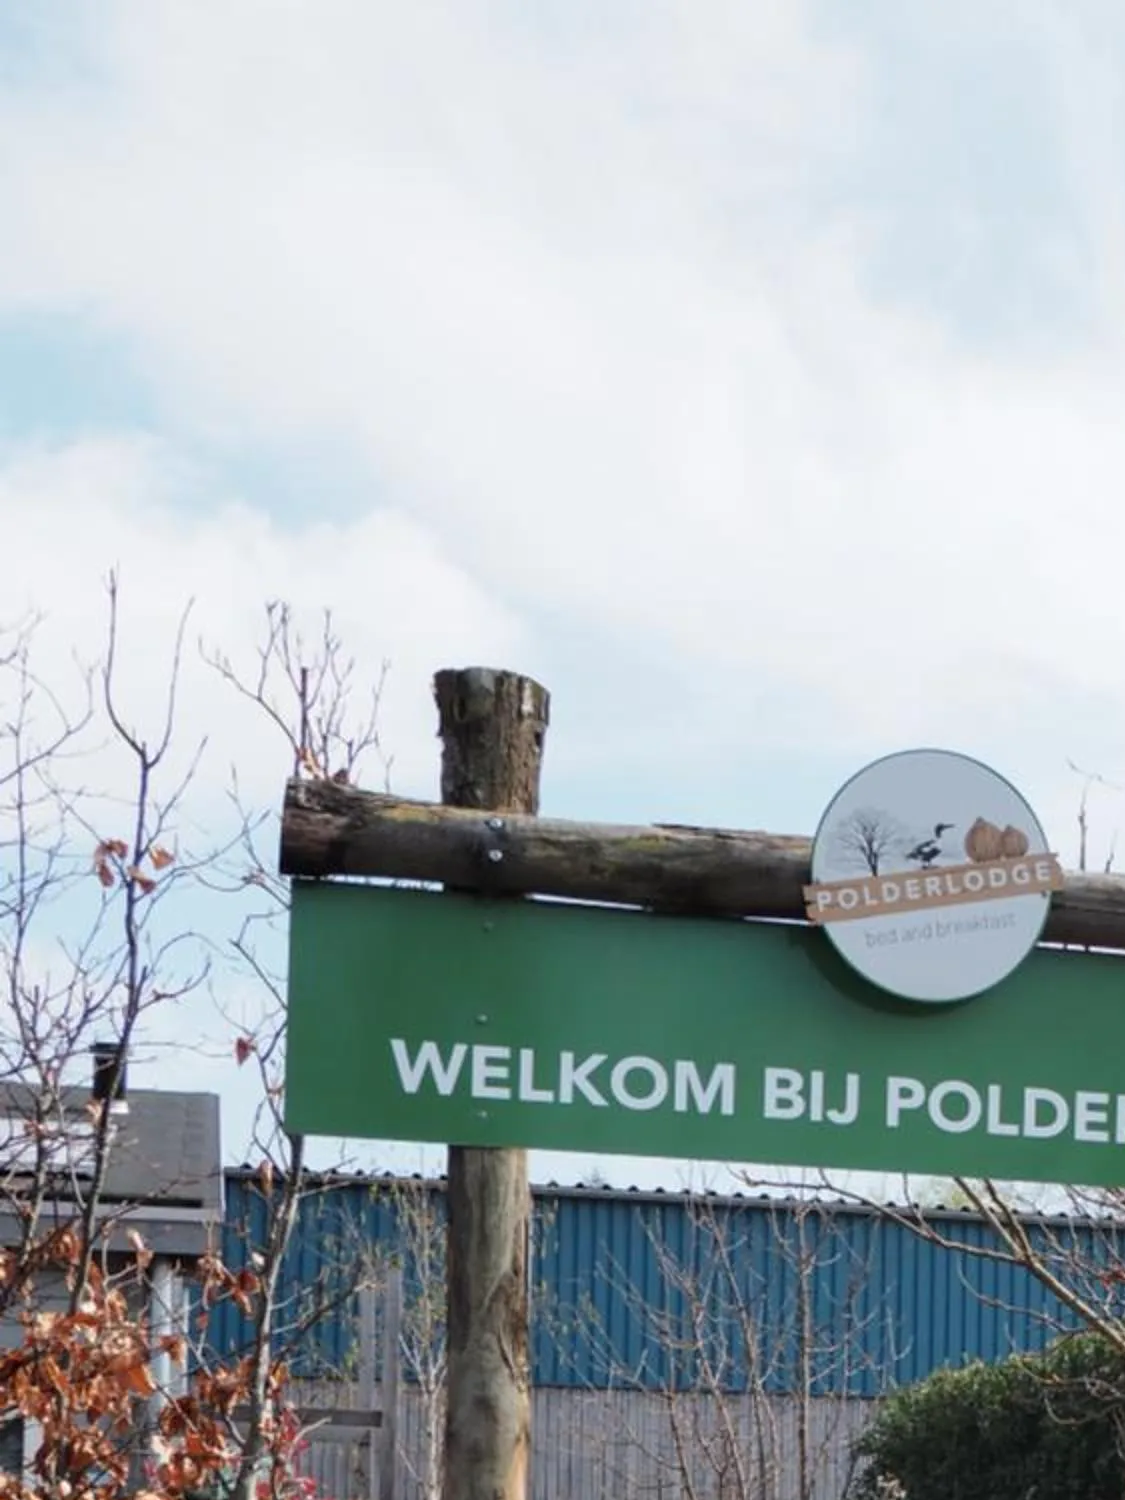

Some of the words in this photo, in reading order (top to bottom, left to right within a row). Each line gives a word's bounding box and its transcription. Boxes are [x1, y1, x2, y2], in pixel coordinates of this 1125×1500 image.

[816, 861, 1050, 912] POLDERLODGE
[864, 928, 898, 948] bed
[901, 922, 933, 942] and
[935, 911, 1016, 939] breakfast
[389, 1038, 735, 1117] WELKOM
[763, 1066, 860, 1125] BIJ
